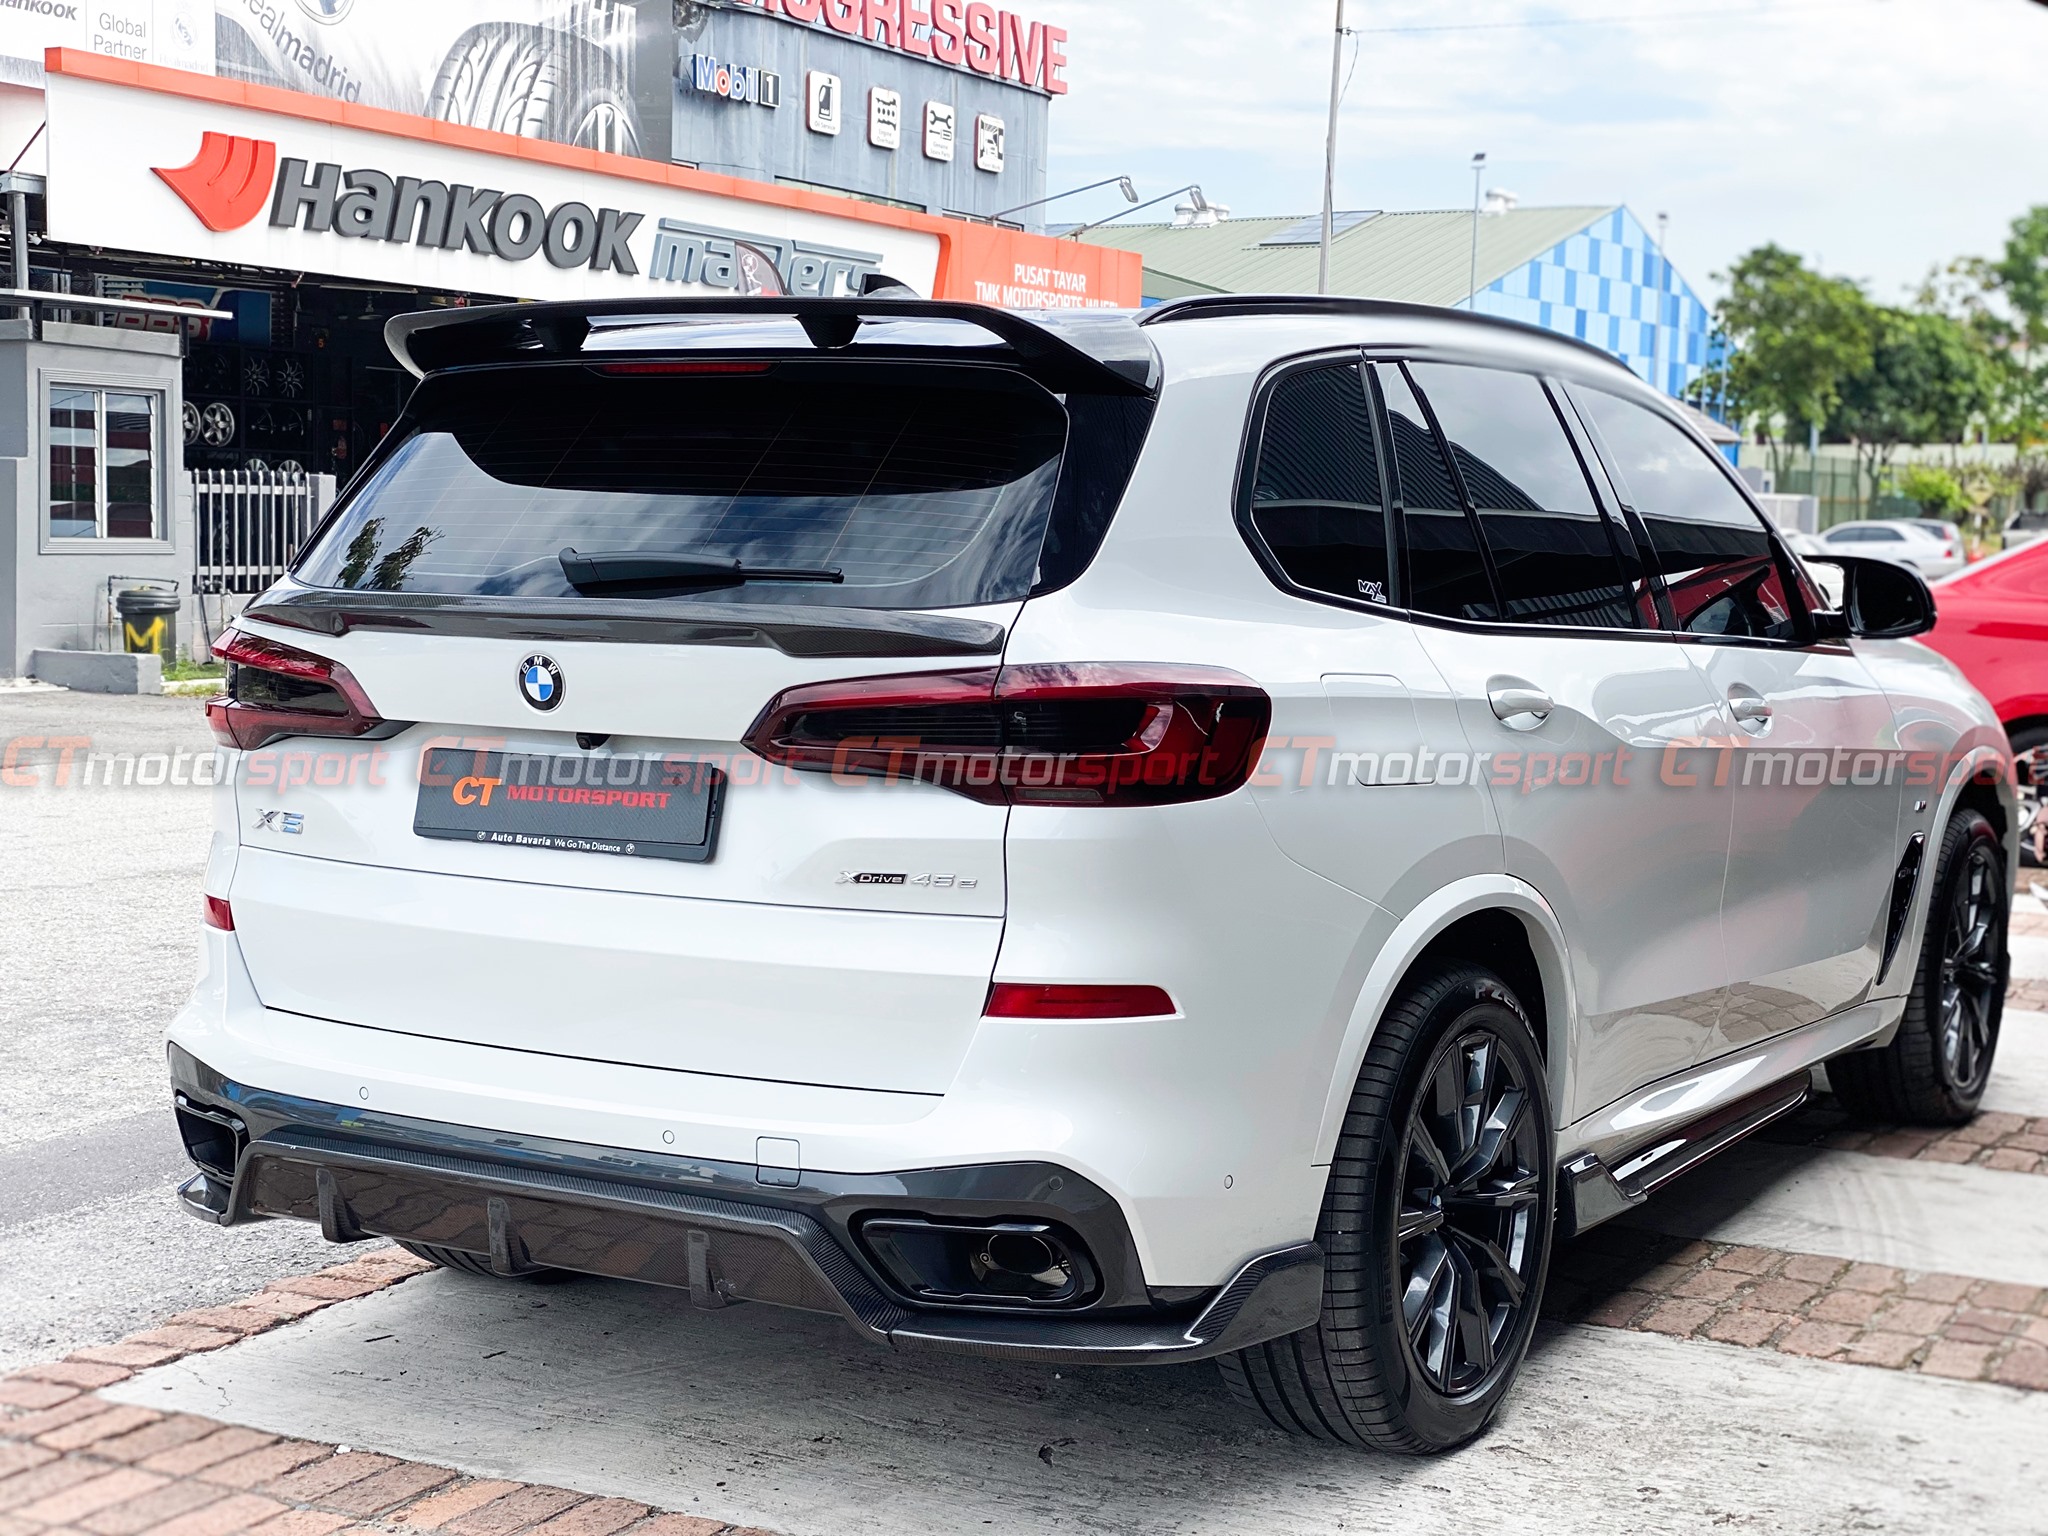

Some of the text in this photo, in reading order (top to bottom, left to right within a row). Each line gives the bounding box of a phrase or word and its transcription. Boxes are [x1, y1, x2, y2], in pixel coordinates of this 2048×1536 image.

[0, 0, 78, 21] ankook
[99, 12, 147, 38] Global
[93, 34, 147, 61] Partner
[242, 0, 362, 103] ealmadrid
[693, 53, 759, 104] Mobil
[1014, 263, 1087, 293] PUSAT TAYAR
[974, 281, 1000, 304] TMK
[521, 655, 559, 675] BMW
[452, 776, 671, 809] CT MOTORSPORT
[251, 808, 305, 835] X5
[491, 832, 621, 852] Auto Bavaria We Go The Distance
